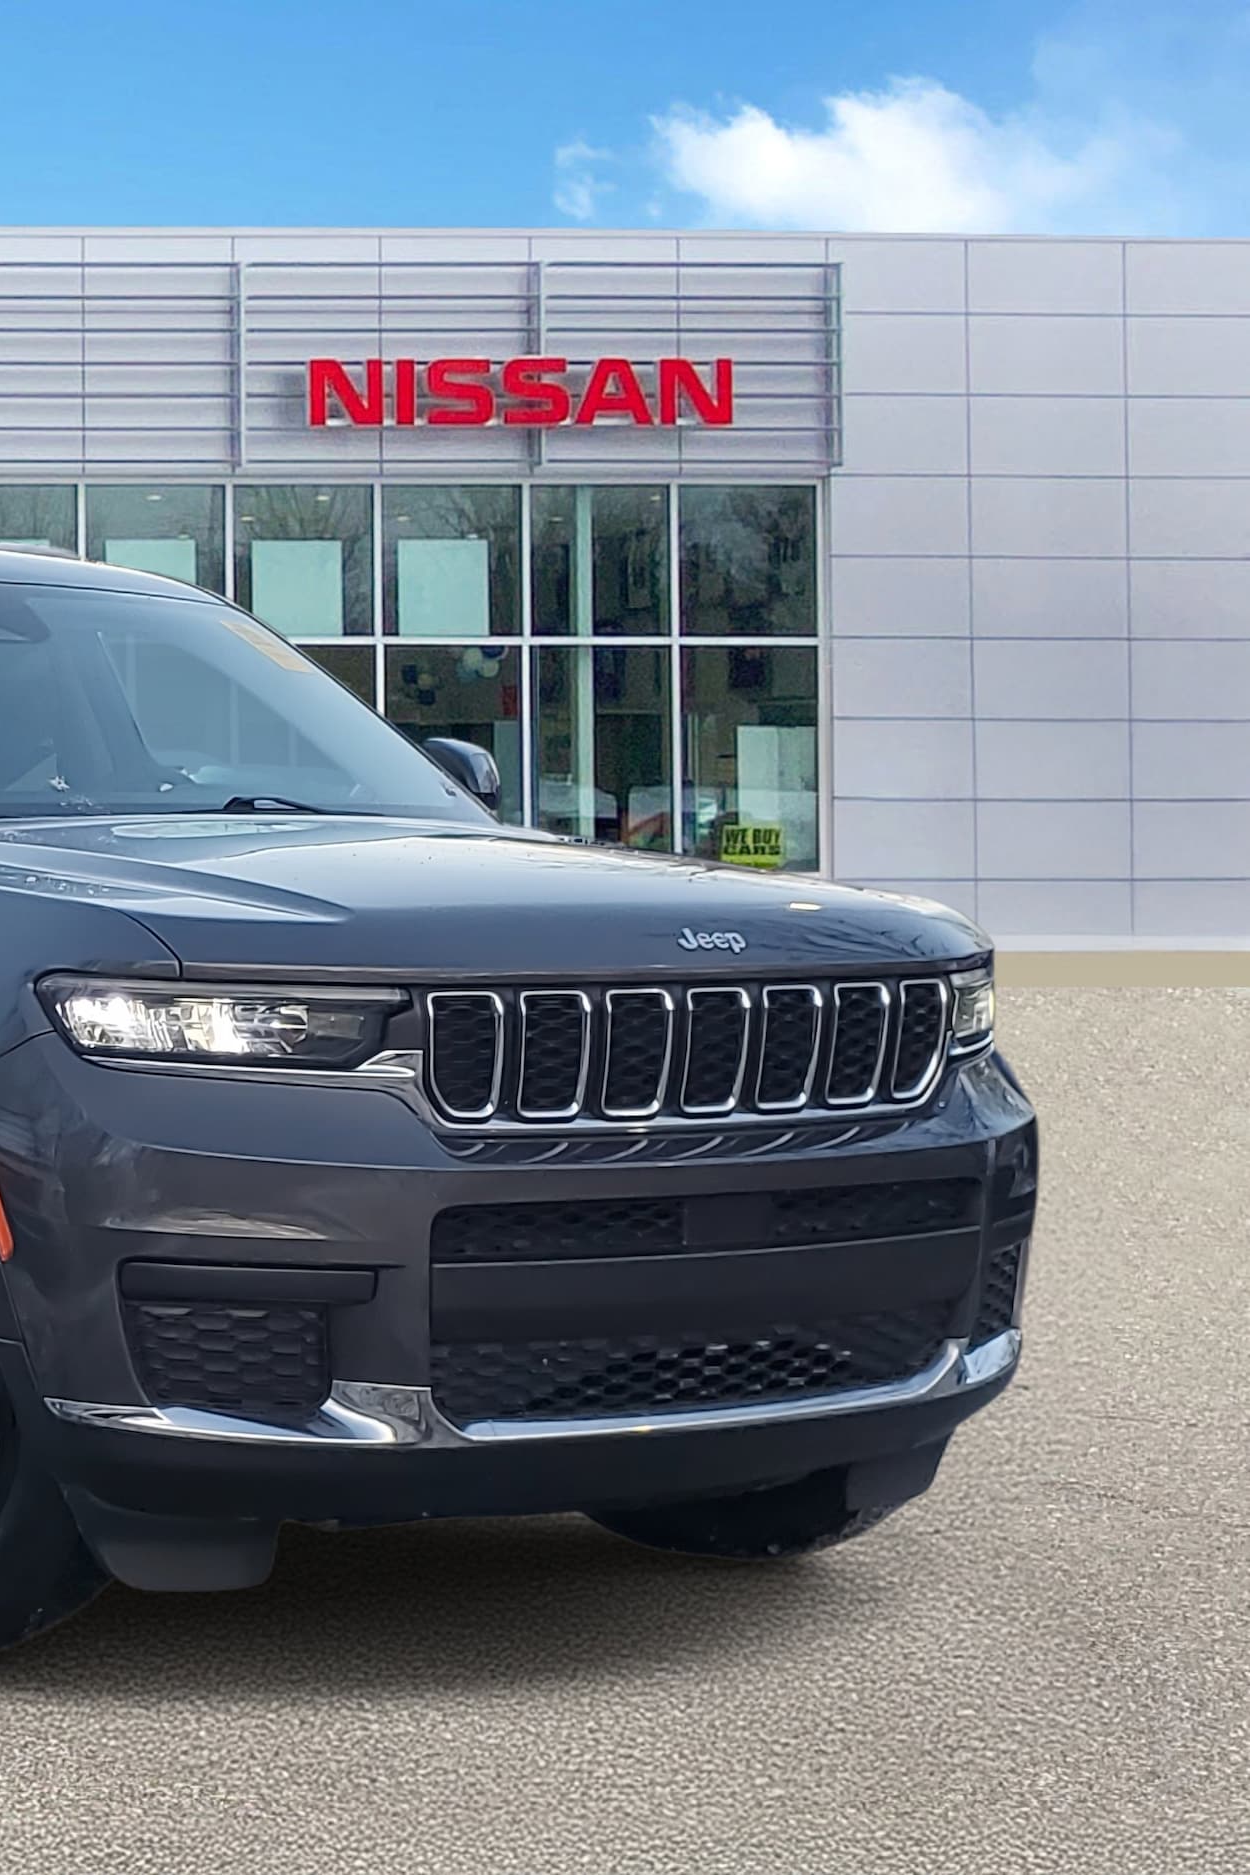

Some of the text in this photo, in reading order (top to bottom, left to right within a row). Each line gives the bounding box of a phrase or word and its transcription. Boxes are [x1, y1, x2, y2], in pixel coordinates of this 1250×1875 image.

[307, 357, 733, 427] NISSAN
[726, 828, 781, 844] WE BUY
[724, 844, 781, 855] CARS
[678, 927, 746, 954] Jeep
